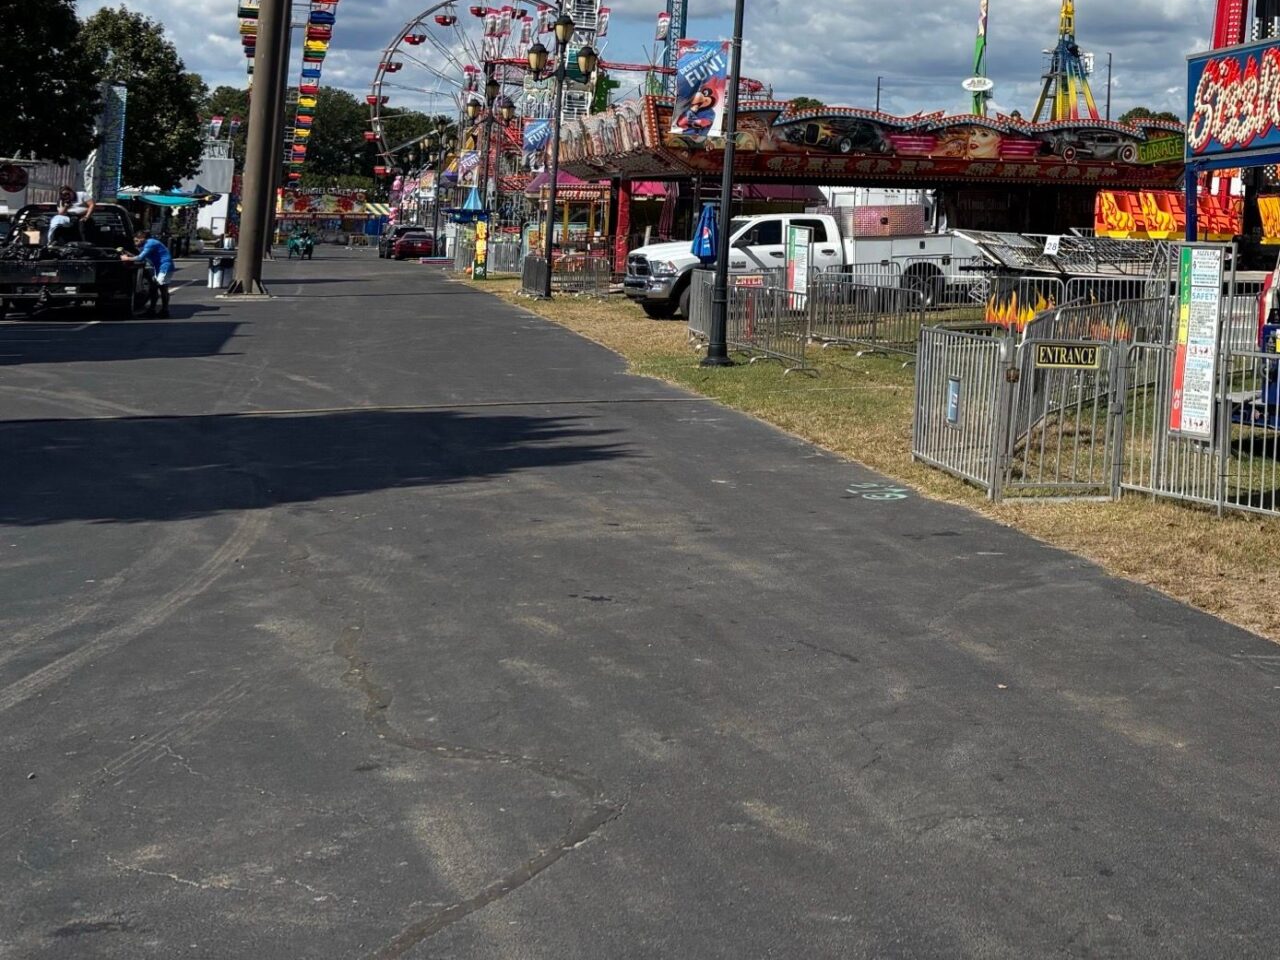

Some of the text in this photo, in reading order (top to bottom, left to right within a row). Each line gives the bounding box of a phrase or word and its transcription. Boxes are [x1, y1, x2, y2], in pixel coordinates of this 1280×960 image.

[685, 54, 725, 87] FUN!
[528, 127, 550, 145] FUN!
[1140, 139, 1183, 161] GARAGE
[1046, 242, 1057, 251] 28
[1192, 292, 1217, 300] SAFETY
[1040, 345, 1095, 365] ENTRANCE
